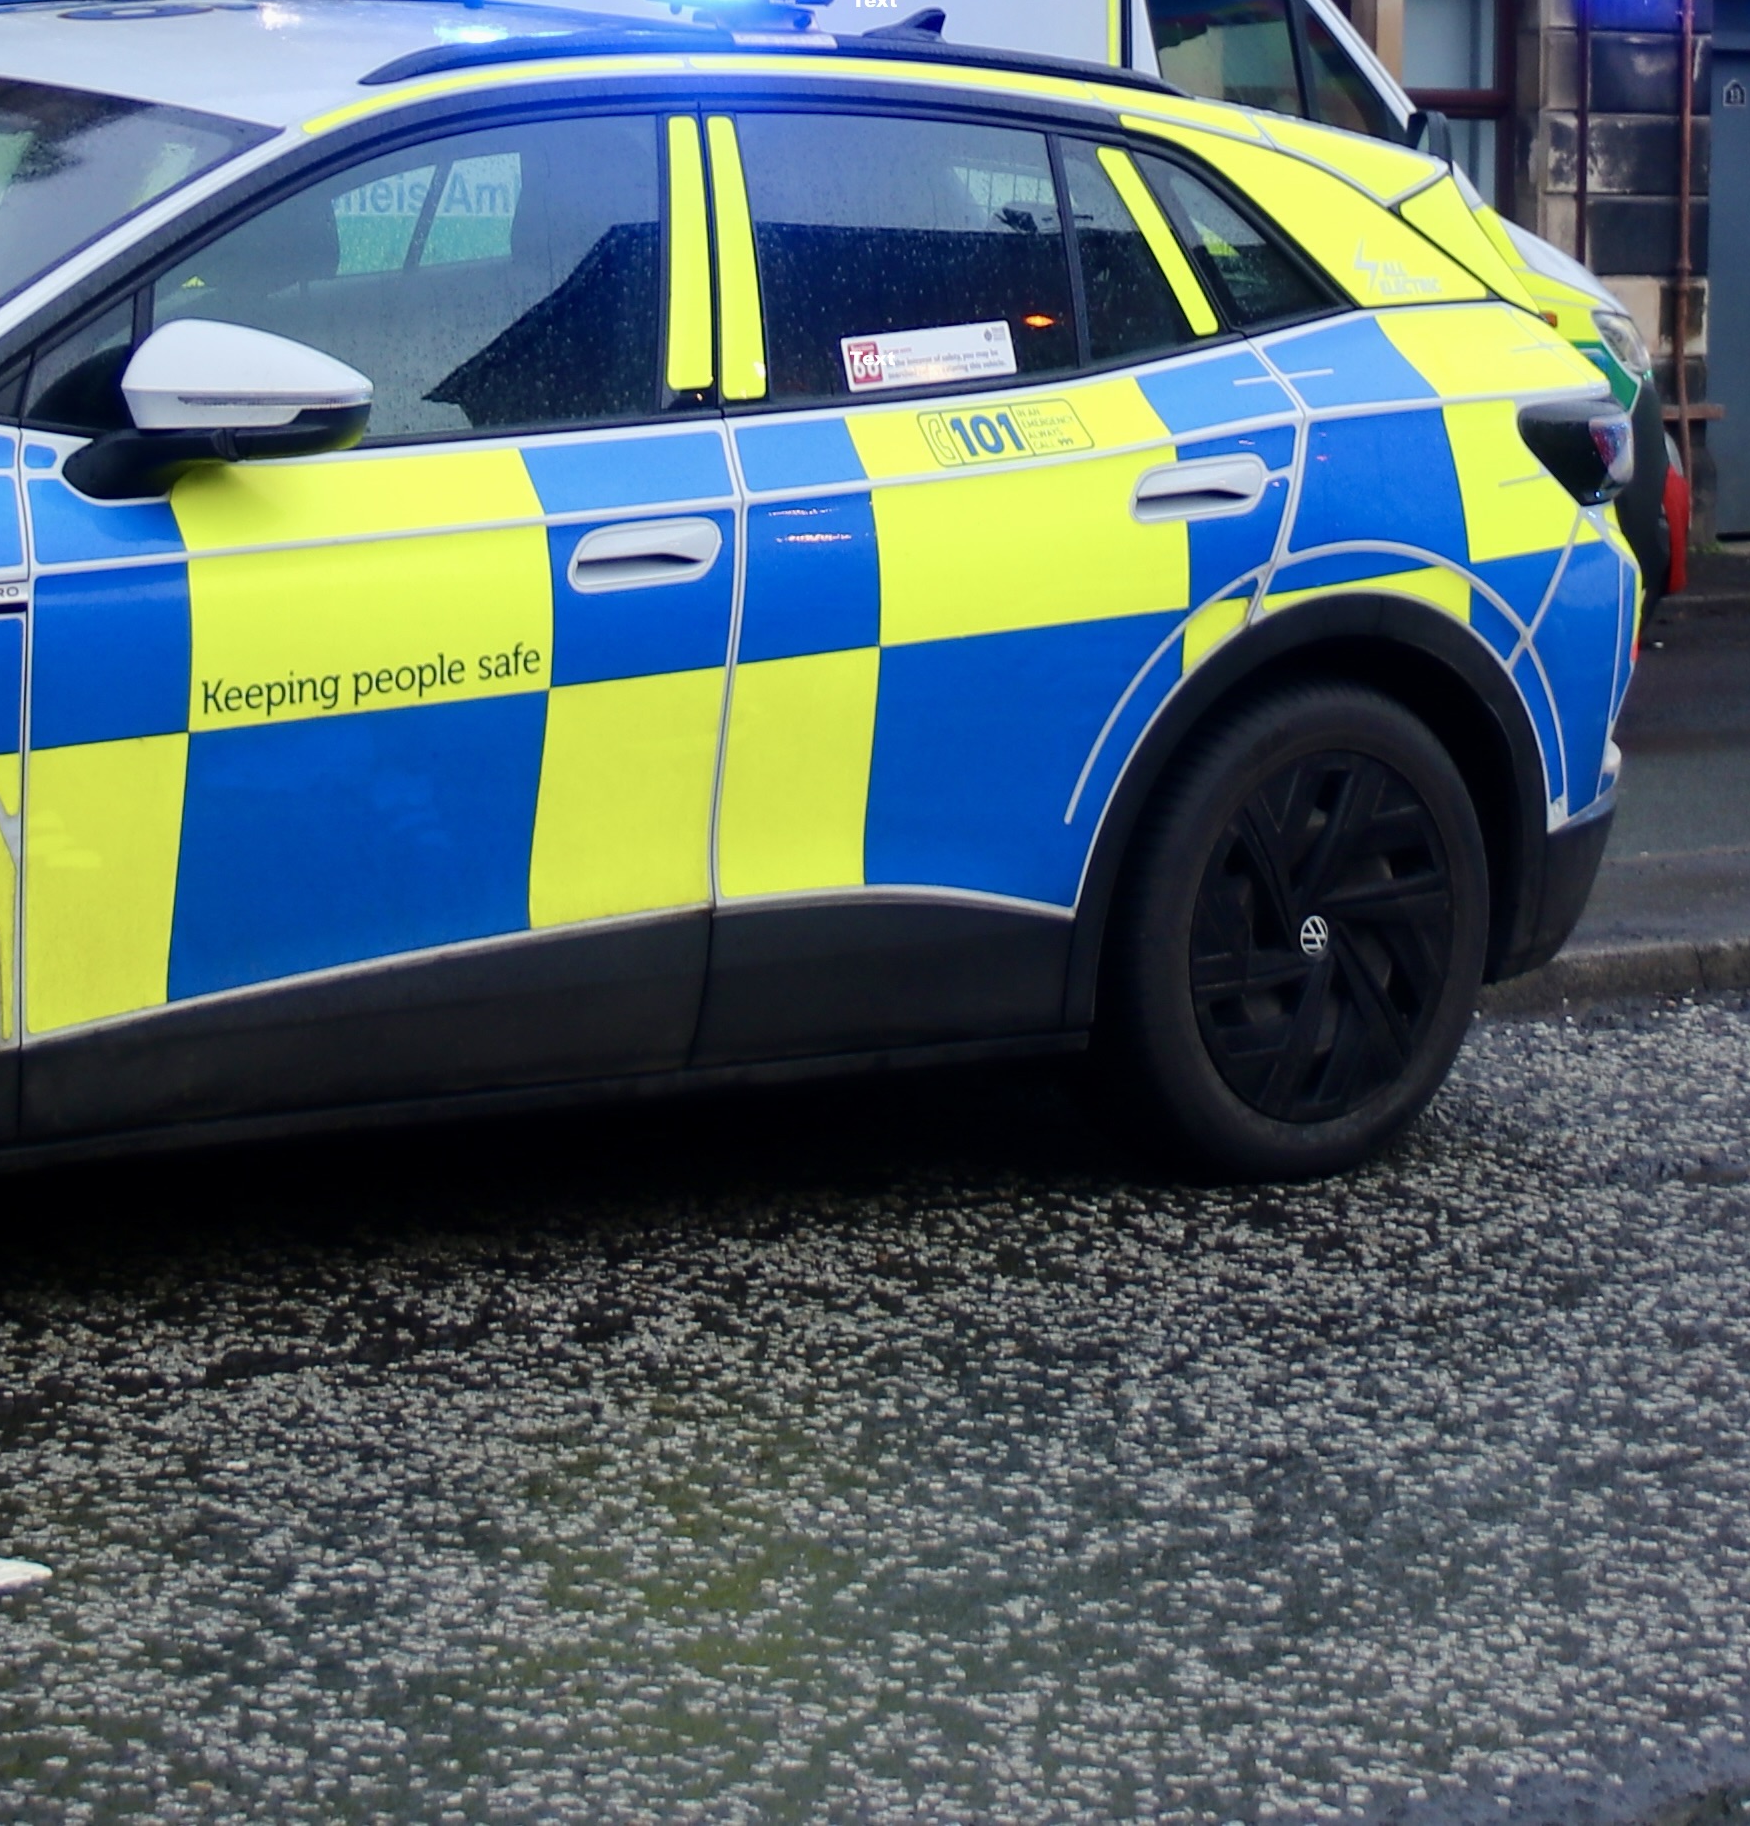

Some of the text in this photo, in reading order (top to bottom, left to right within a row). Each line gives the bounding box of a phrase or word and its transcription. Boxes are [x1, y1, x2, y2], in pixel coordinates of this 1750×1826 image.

[949, 411, 1027, 458] 101
[1020, 415, 1073, 429] EMERGENCY
[1028, 426, 1064, 440] ALWAYS
[202, 641, 542, 717] Keeping people safe
